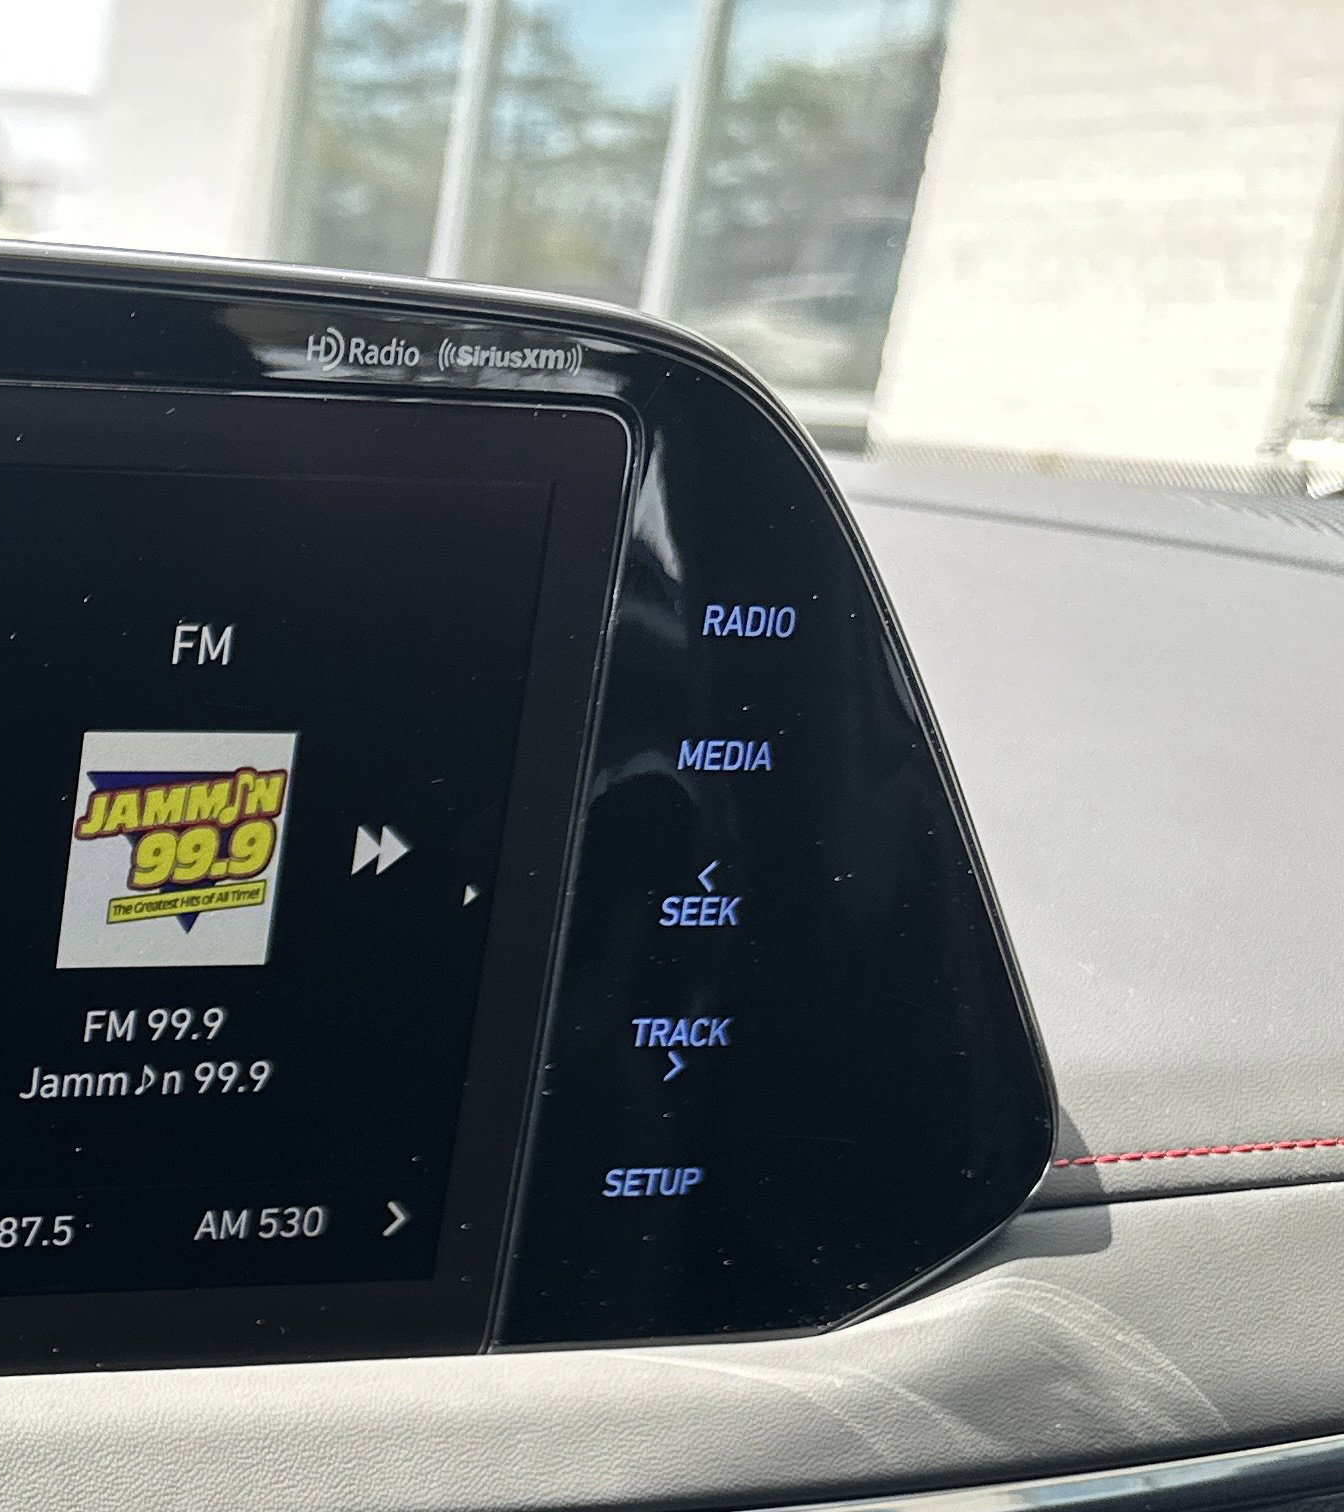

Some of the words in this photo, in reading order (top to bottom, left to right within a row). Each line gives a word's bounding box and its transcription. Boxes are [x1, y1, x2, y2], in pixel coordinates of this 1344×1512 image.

[348, 337, 420, 367] Radio
[703, 605, 795, 637] RADIO
[172, 625, 232, 665] FM
[678, 740, 770, 770] MEDIA
[130, 820, 275, 888] 99.9
[112, 903, 133, 916] The
[133, 897, 179, 913] Greatest
[179, 896, 204, 908] Hits
[202, 896, 216, 905] of
[216, 892, 230, 903] All
[660, 896, 740, 926] SEEK
[84, 1011, 135, 1042] FM
[148, 1008, 223, 1040] 99.9
[632, 1019, 729, 1046] TRACK
[195, 1061, 270, 1093] 99.9
[603, 1168, 700, 1197] SETUP
[194, 1210, 248, 1240] AM
[259, 1206, 323, 1238] 530
